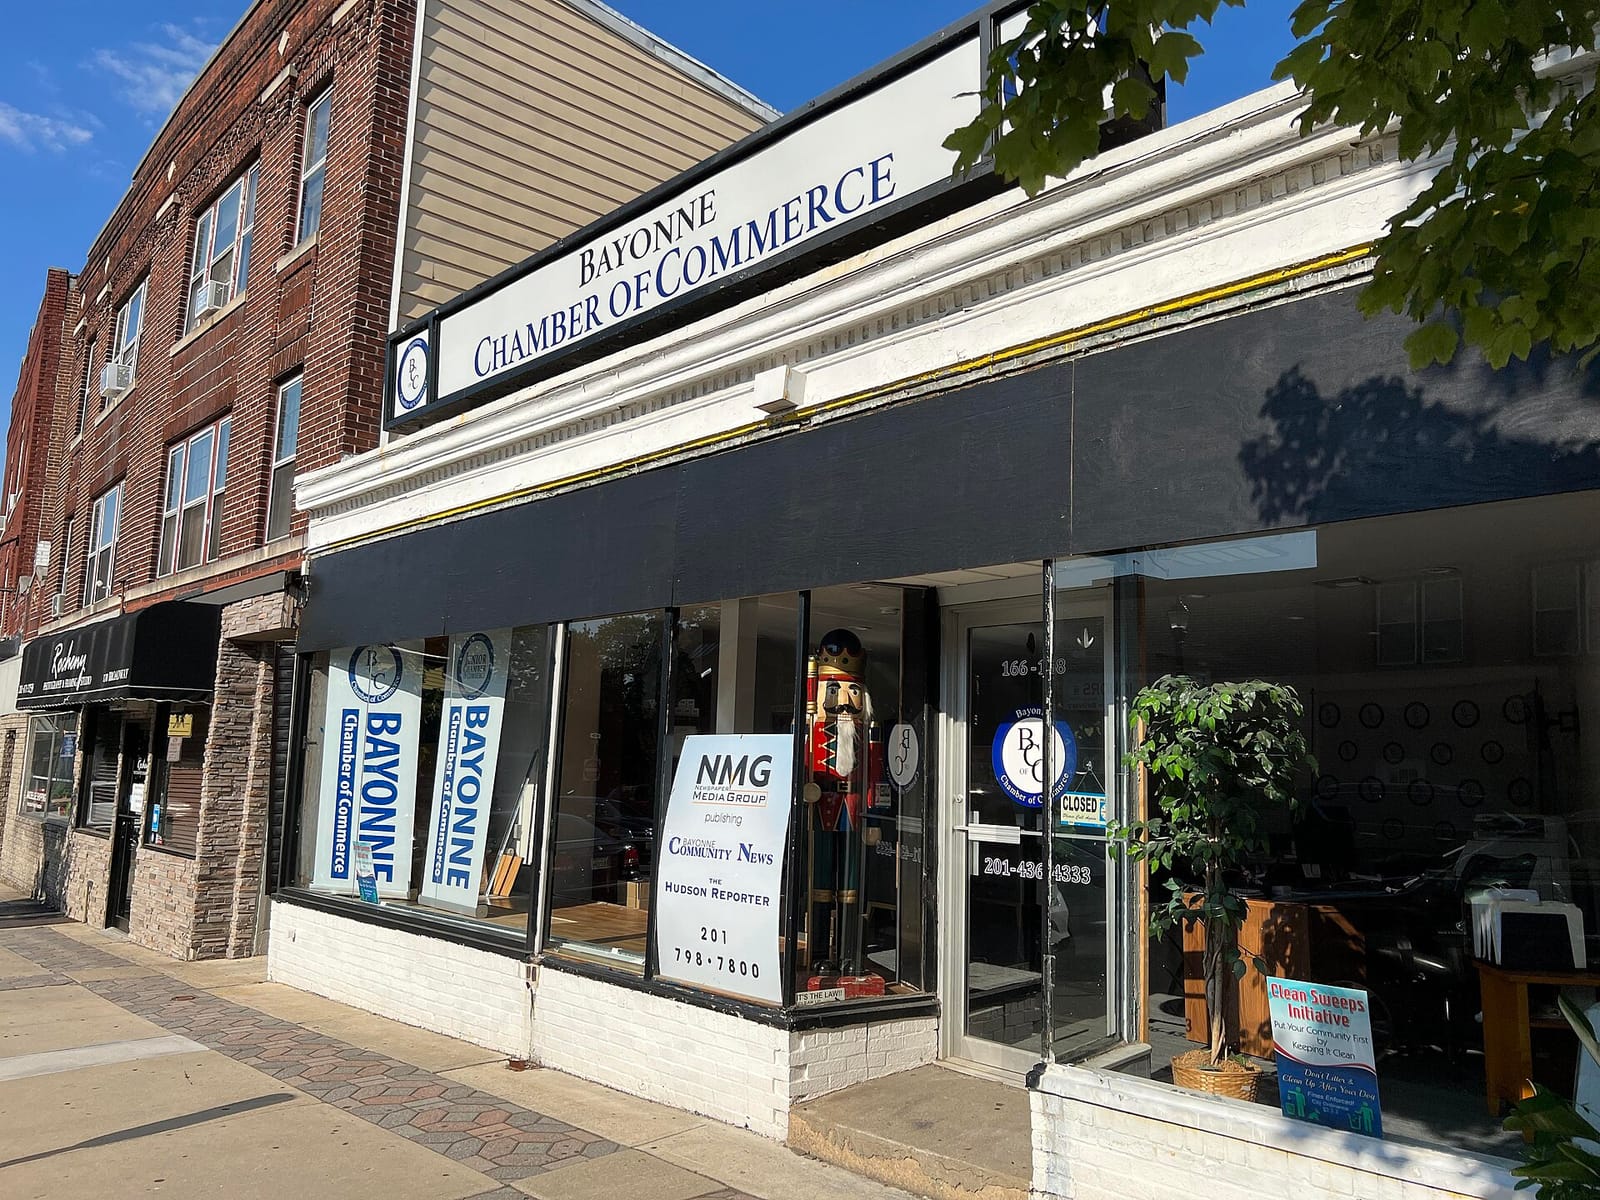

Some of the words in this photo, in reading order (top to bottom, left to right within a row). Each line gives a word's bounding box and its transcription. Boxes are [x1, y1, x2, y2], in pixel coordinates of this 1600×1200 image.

[579, 190, 717, 288] BAYONNE
[474, 295, 601, 378] CHAMBER
[609, 270, 651, 318] OF
[655, 152, 896, 298] COMMERCE
[1001, 658, 1066, 676] 166-18
[1015, 706, 1044, 718] Bayon
[341, 714, 357, 778] Chamber
[445, 711, 461, 777] Chamber
[696, 754, 773, 787] NMG
[340, 781, 353, 797] of
[356, 712, 402, 882] BAYONNE
[442, 780, 453, 798] of
[446, 705, 491, 889] BAYONNE
[1000, 774, 1027, 802] Chamber
[1028, 795, 1037, 805] of
[1037, 772, 1069, 804] Cmerce
[1062, 795, 1098, 813] CLOSED
[704, 812, 743, 827] publishing
[334, 799, 352, 874] Commerce
[434, 800, 450, 877] Commerce
[683, 838, 716, 848] BAYONNE
[669, 836, 732, 860] COMMUNITY
[737, 842, 774, 865] NEWS
[984, 857, 1091, 885] 201-4364333
[665, 881, 707, 897] HUDSON
[711, 887, 770, 906] REPORTER
[700, 926, 728, 945] 201
[810, 991, 823, 1000] THE
[1271, 983, 1307, 1004] Clean
[1310, 989, 1366, 1014] Sweeps
[1287, 1003, 1350, 1027] Initiative
[1273, 1020, 1286, 1030] Put
[1287, 1021, 1304, 1033] Your
[1306, 1026, 1352, 1041] Community
[1353, 1034, 1369, 1044] First
[1317, 1037, 1328, 1047] by
[1292, 1041, 1324, 1056] Keeping
[1333, 1048, 1356, 1060] Clean
[1282, 1073, 1303, 1085] Clean
[1305, 1078, 1316, 1089] Up
[1304, 1068, 1325, 1079] Don't
